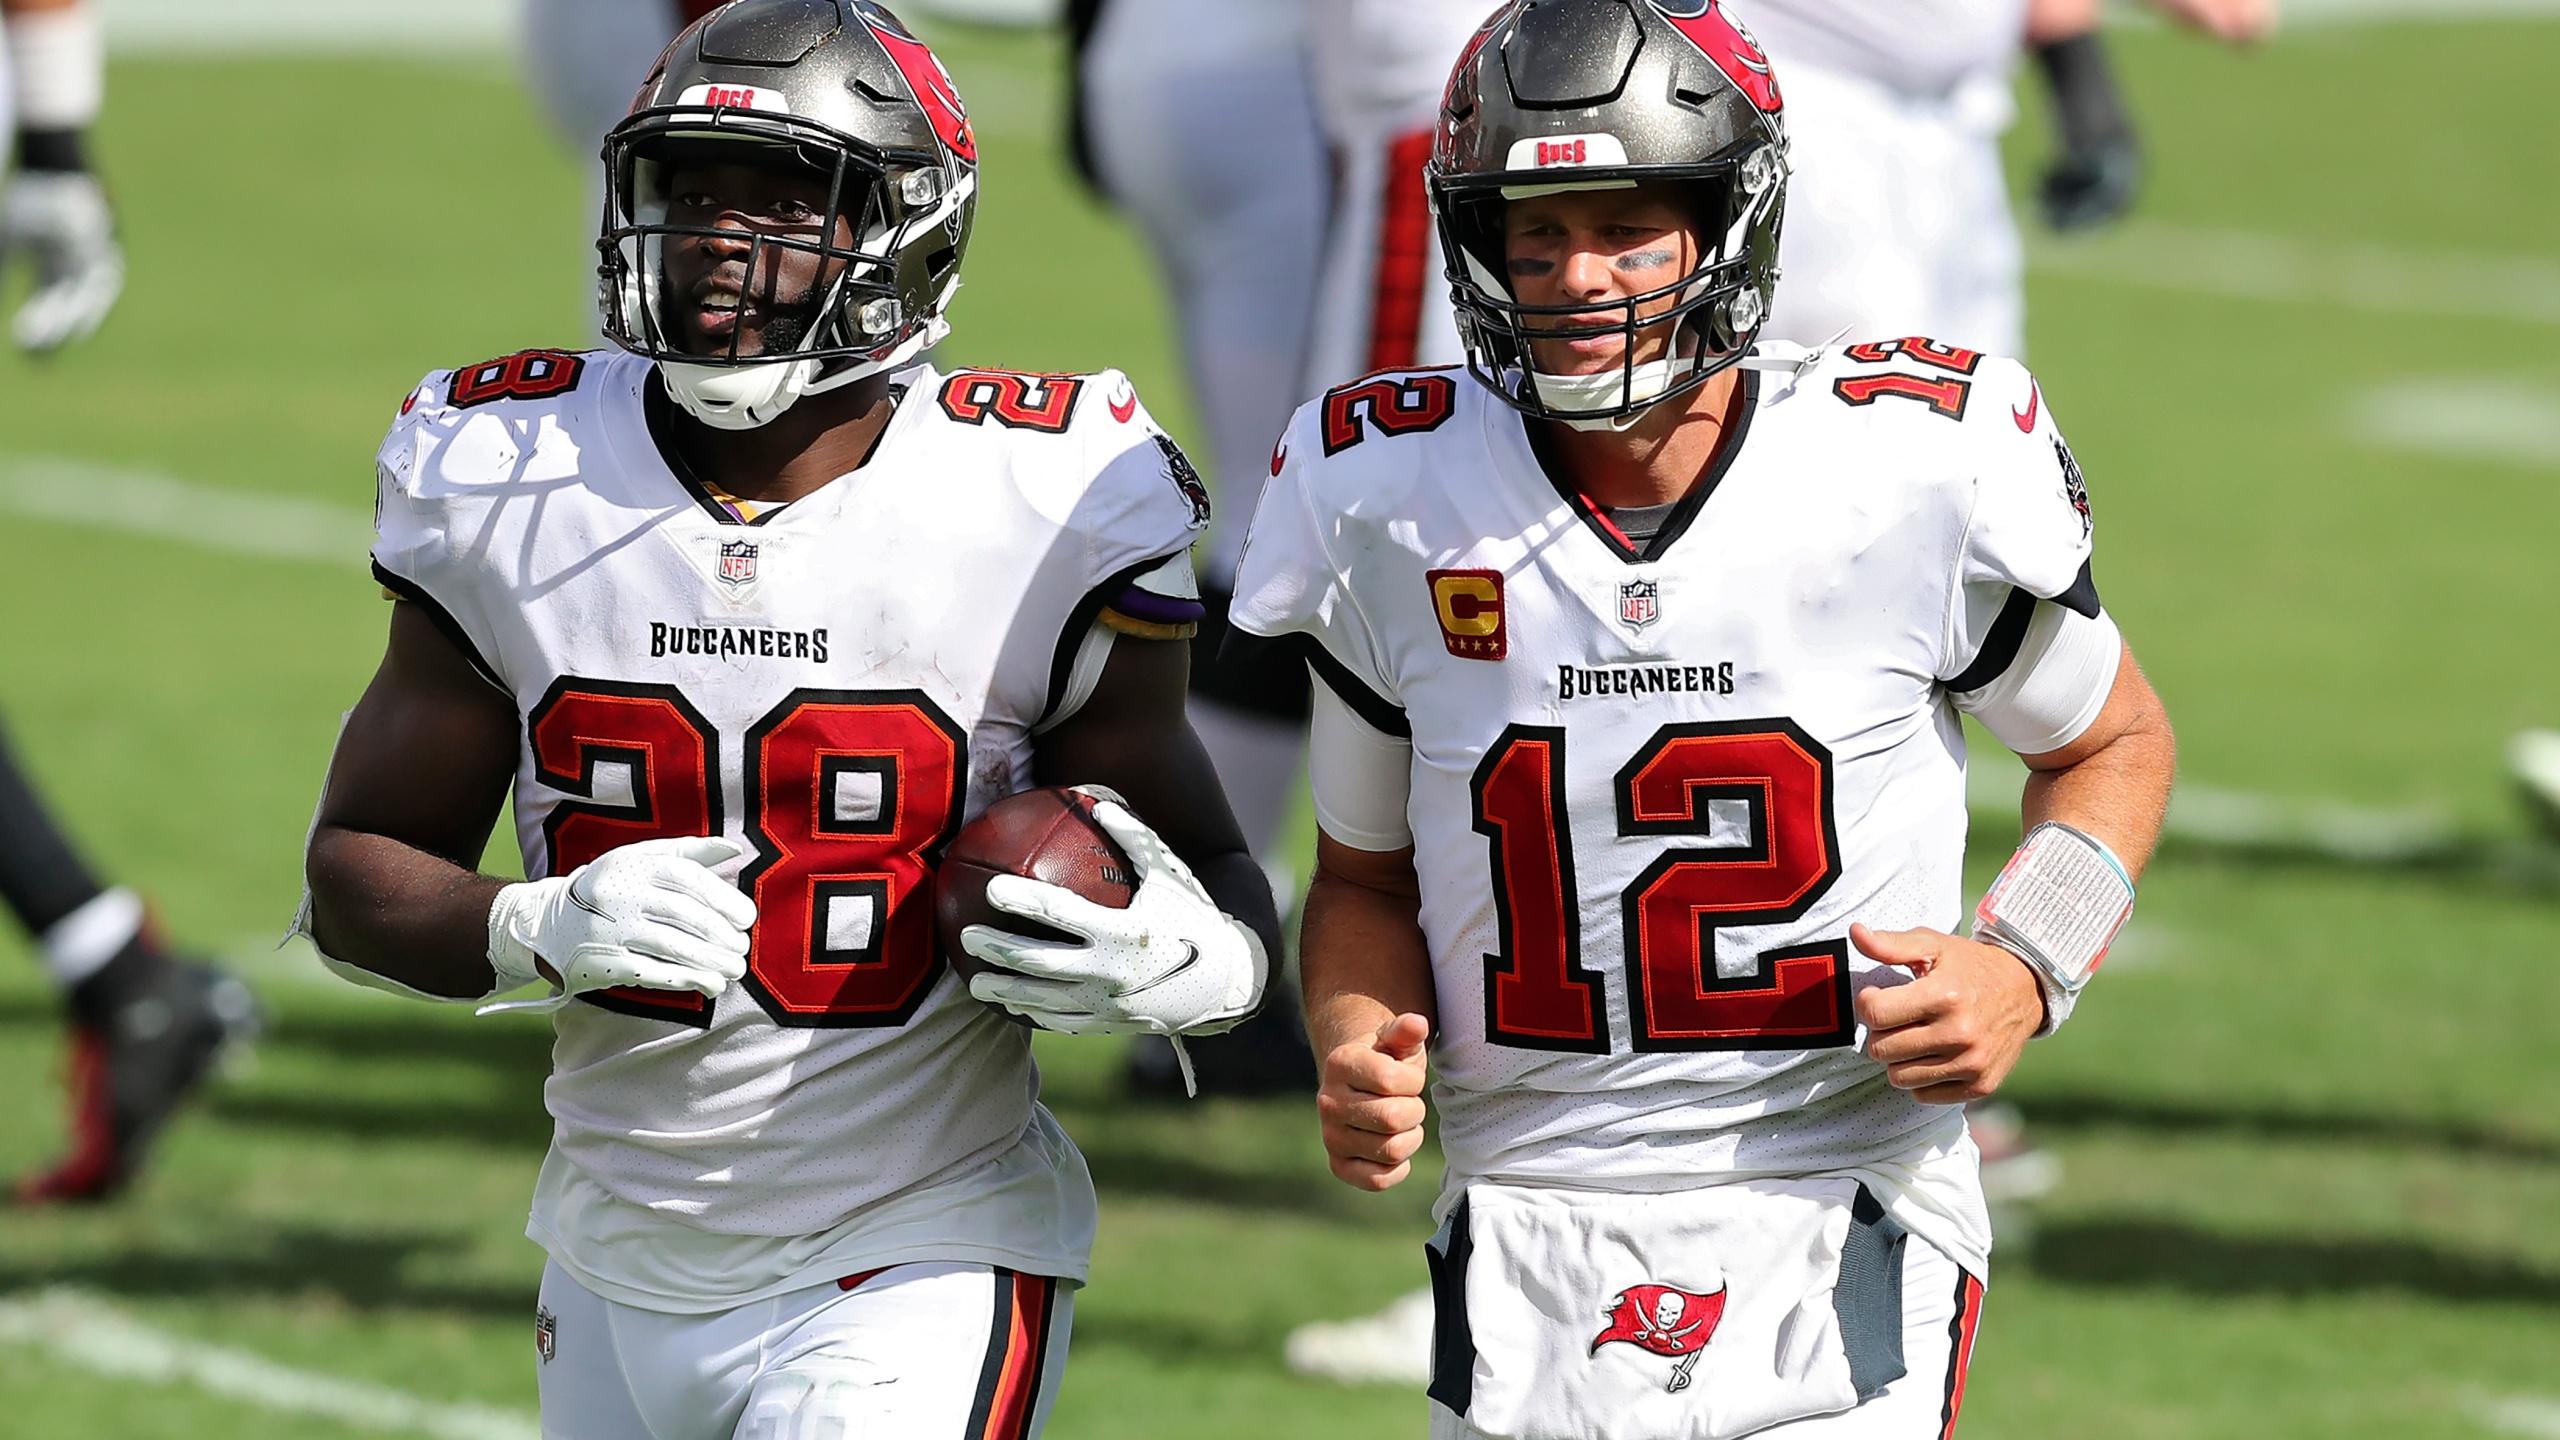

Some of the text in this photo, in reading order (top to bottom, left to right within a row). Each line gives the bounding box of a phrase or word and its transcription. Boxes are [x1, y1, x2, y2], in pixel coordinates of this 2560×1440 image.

[705, 86, 755, 110] BUCS
[1536, 139, 1586, 166] BUCS
[722, 557, 754, 578] NFL
[1434, 576, 1500, 637] C
[1622, 598, 1656, 621] NFL
[649, 621, 828, 663] BUCCANEERS
[1557, 661, 1735, 701] BUCCANEERS
[527, 675, 969, 1029] 28
[1470, 717, 1856, 1055] 12
